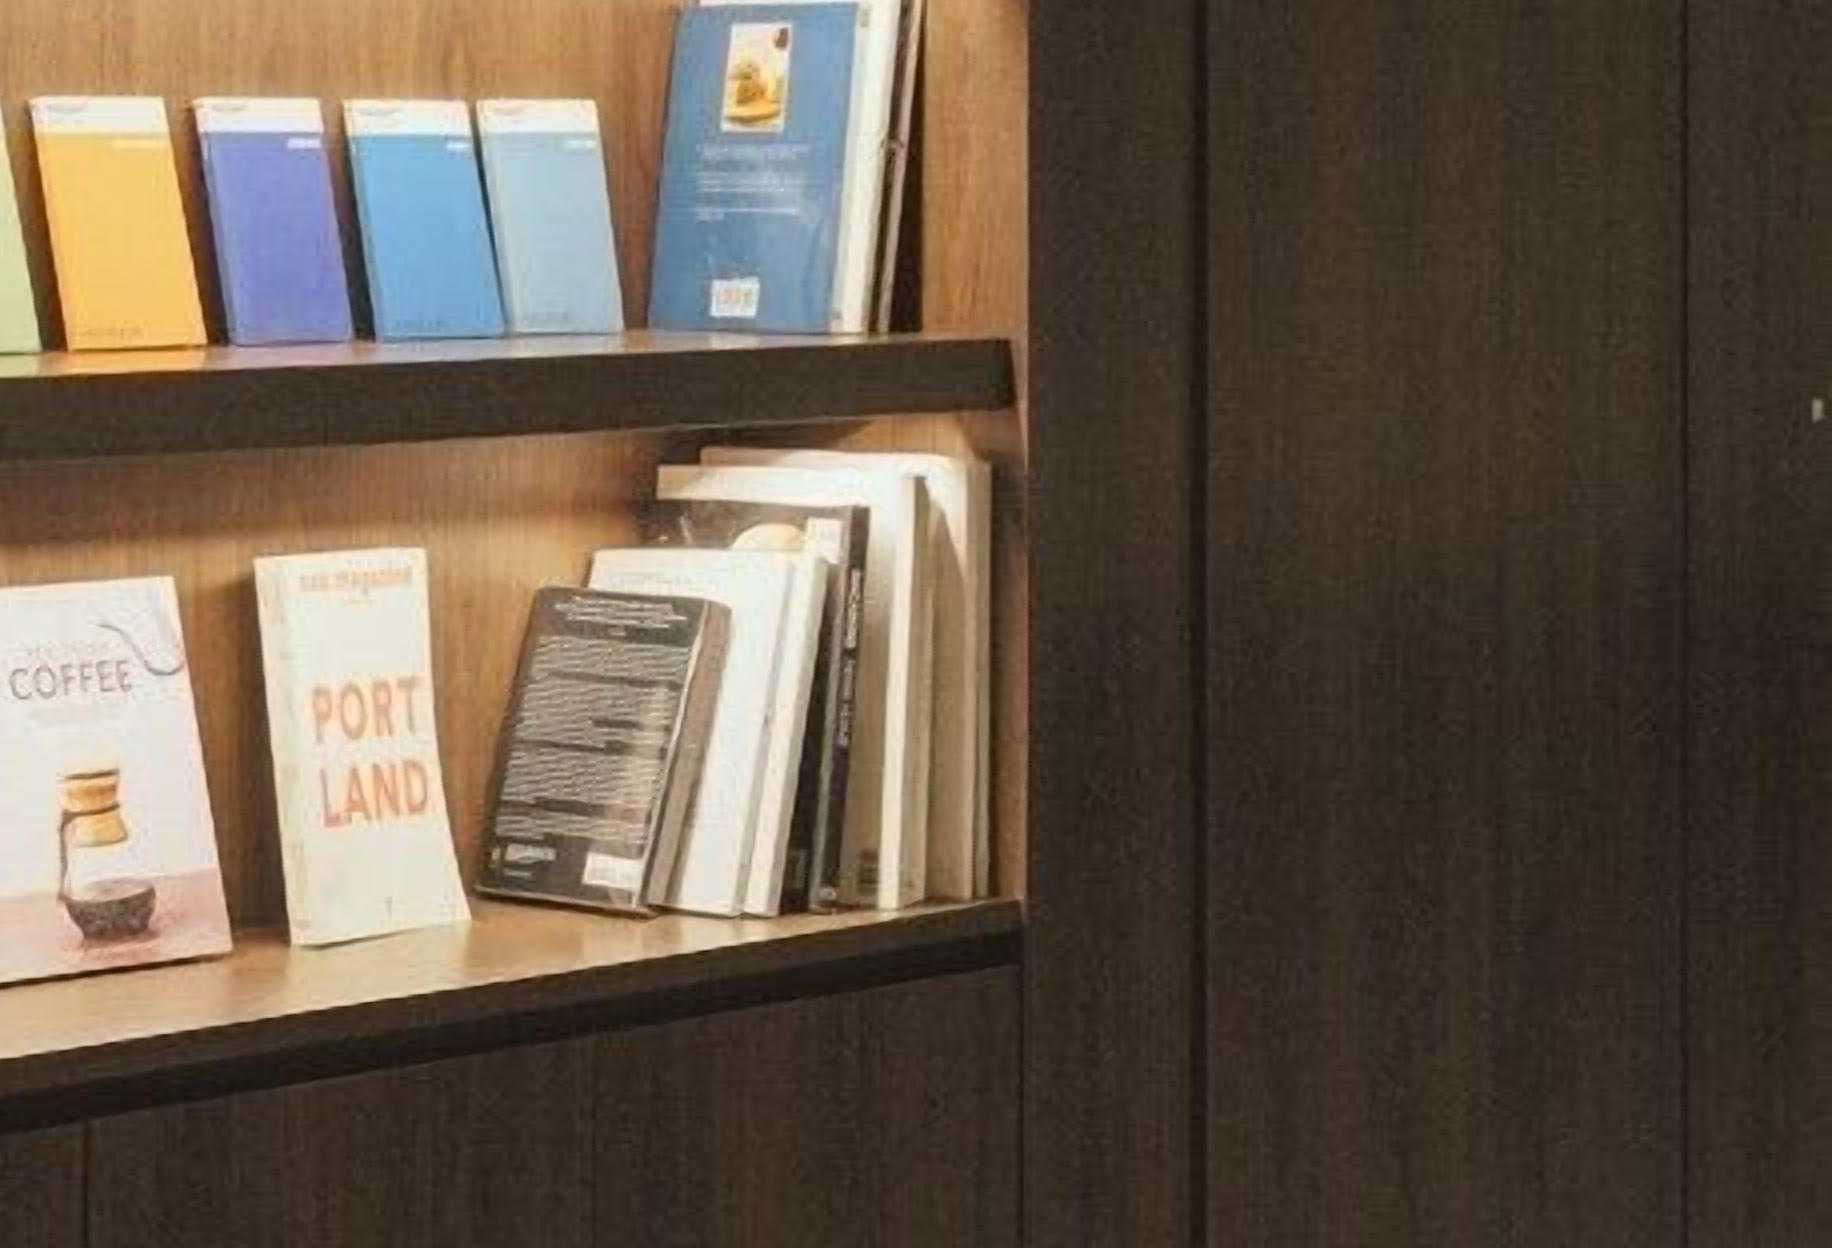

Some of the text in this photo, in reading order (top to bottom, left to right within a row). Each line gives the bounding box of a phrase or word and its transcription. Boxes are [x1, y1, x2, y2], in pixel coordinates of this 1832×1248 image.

[8, 658, 132, 701] COFFEE
[311, 675, 420, 744] PORT
[319, 760, 429, 829] LAND
